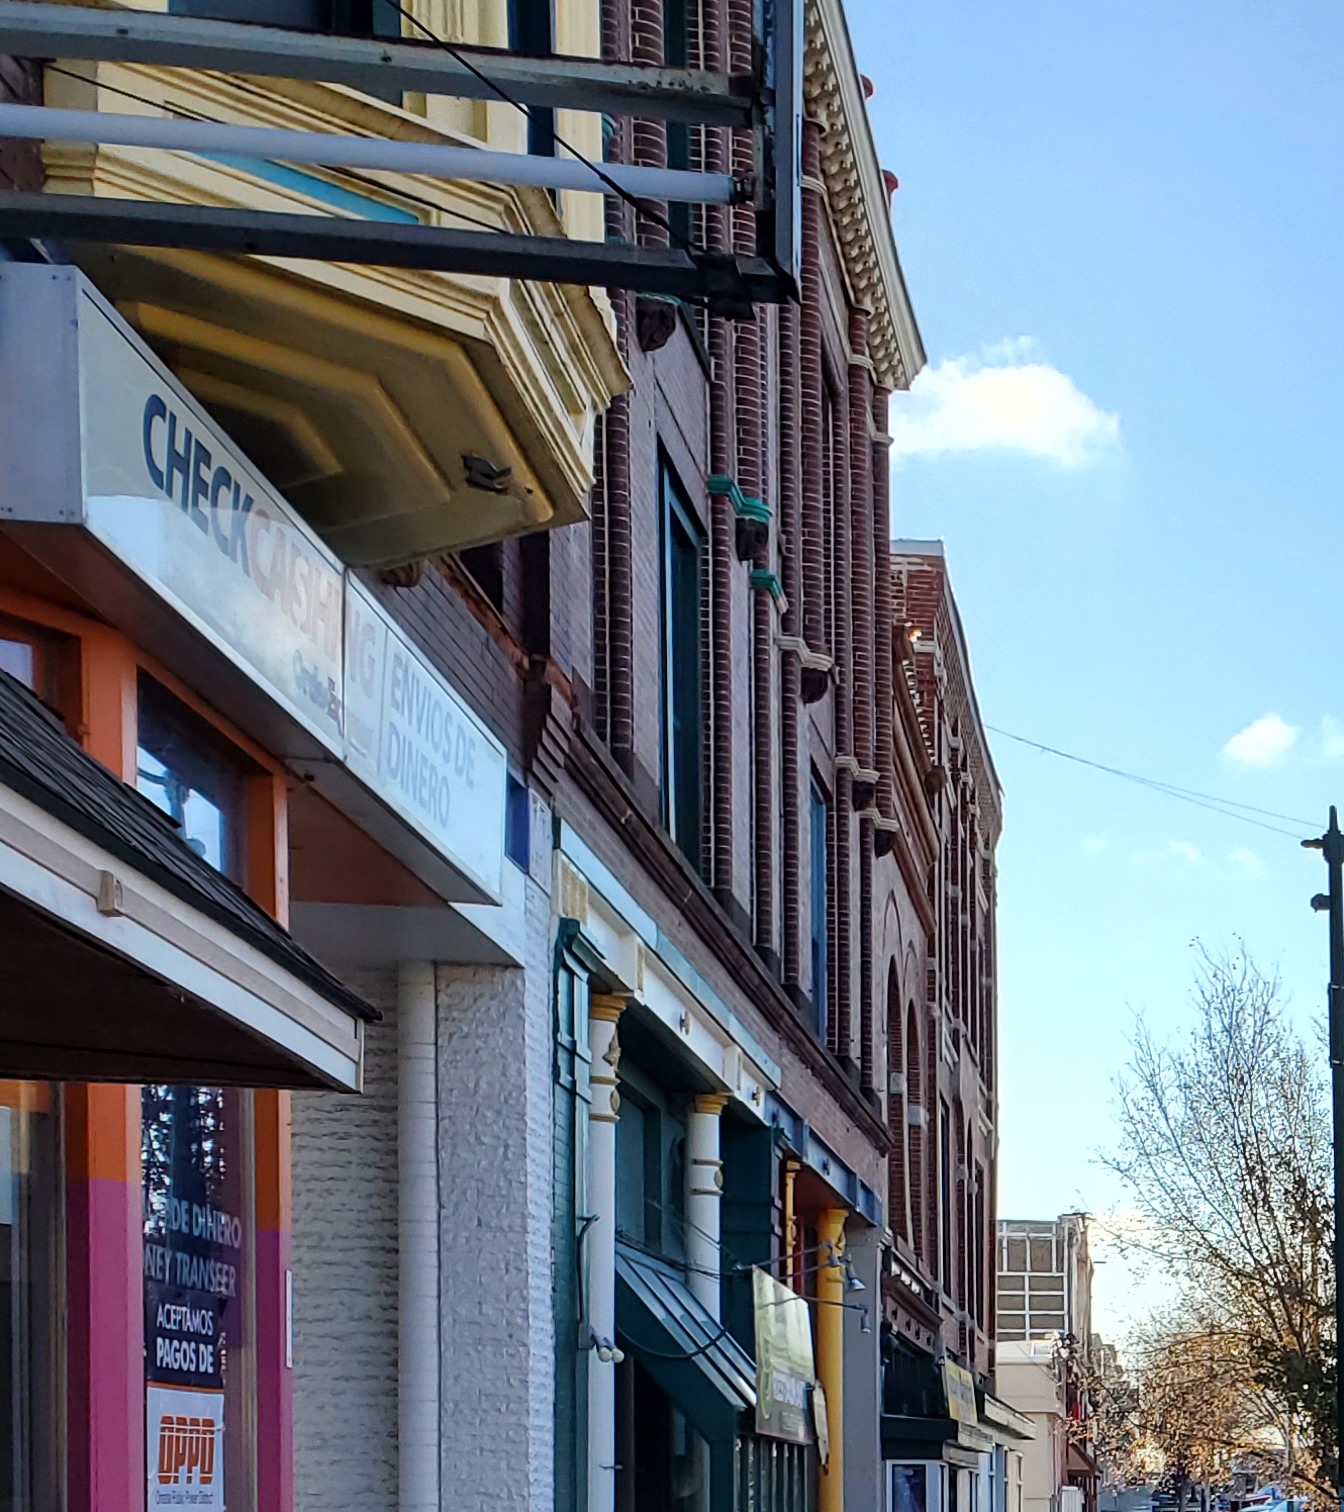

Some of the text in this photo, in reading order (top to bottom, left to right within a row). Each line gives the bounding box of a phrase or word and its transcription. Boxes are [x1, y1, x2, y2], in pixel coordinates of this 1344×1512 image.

[142, 393, 255, 579] CHECK
[386, 721, 450, 830] DINERO
[156, 1302, 214, 1337] ACEPTAMOS
[156, 1336, 214, 1374] PAGOS DE
